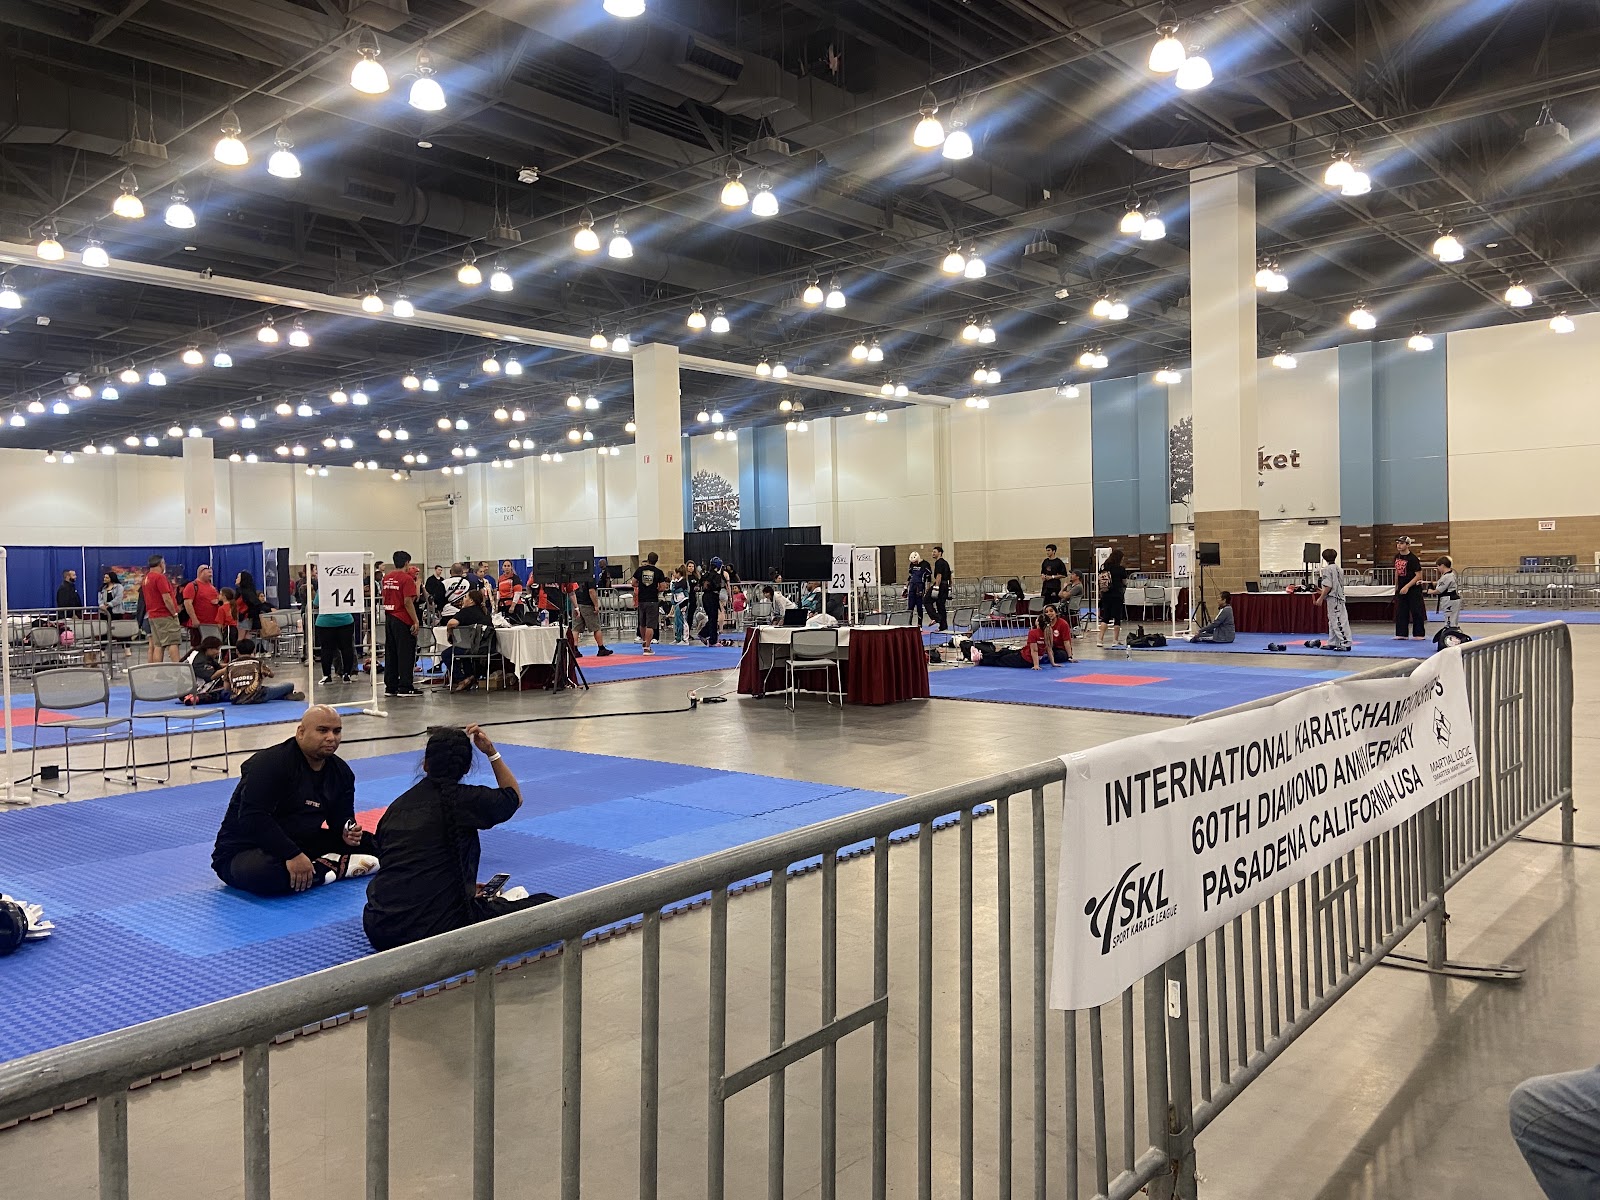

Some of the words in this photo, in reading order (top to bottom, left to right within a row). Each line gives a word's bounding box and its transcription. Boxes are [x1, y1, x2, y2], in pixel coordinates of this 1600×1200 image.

[494, 505, 523, 514] EMERGENCY
[693, 496, 740, 512] marke
[1178, 565, 1186, 575] 22
[832, 573, 846, 589] 23
[331, 588, 356, 607] 14
[1105, 730, 1292, 826] INTERNATIONAL
[1294, 707, 1351, 757] KARATE
[1429, 754, 1456, 773] MARTIAL
[1192, 799, 1250, 855] 60TH
[1258, 763, 1328, 830] DIAMOND
[1202, 824, 1308, 913] PASADENA
[1309, 779, 1398, 848] CALIFORNIA
[1391, 764, 1424, 800] USA
[1120, 868, 1169, 928] SKL
[1112, 927, 1130, 949] SPORT
[1130, 915, 1155, 937] KARATE
[1155, 904, 1178, 925] LEAGUE
